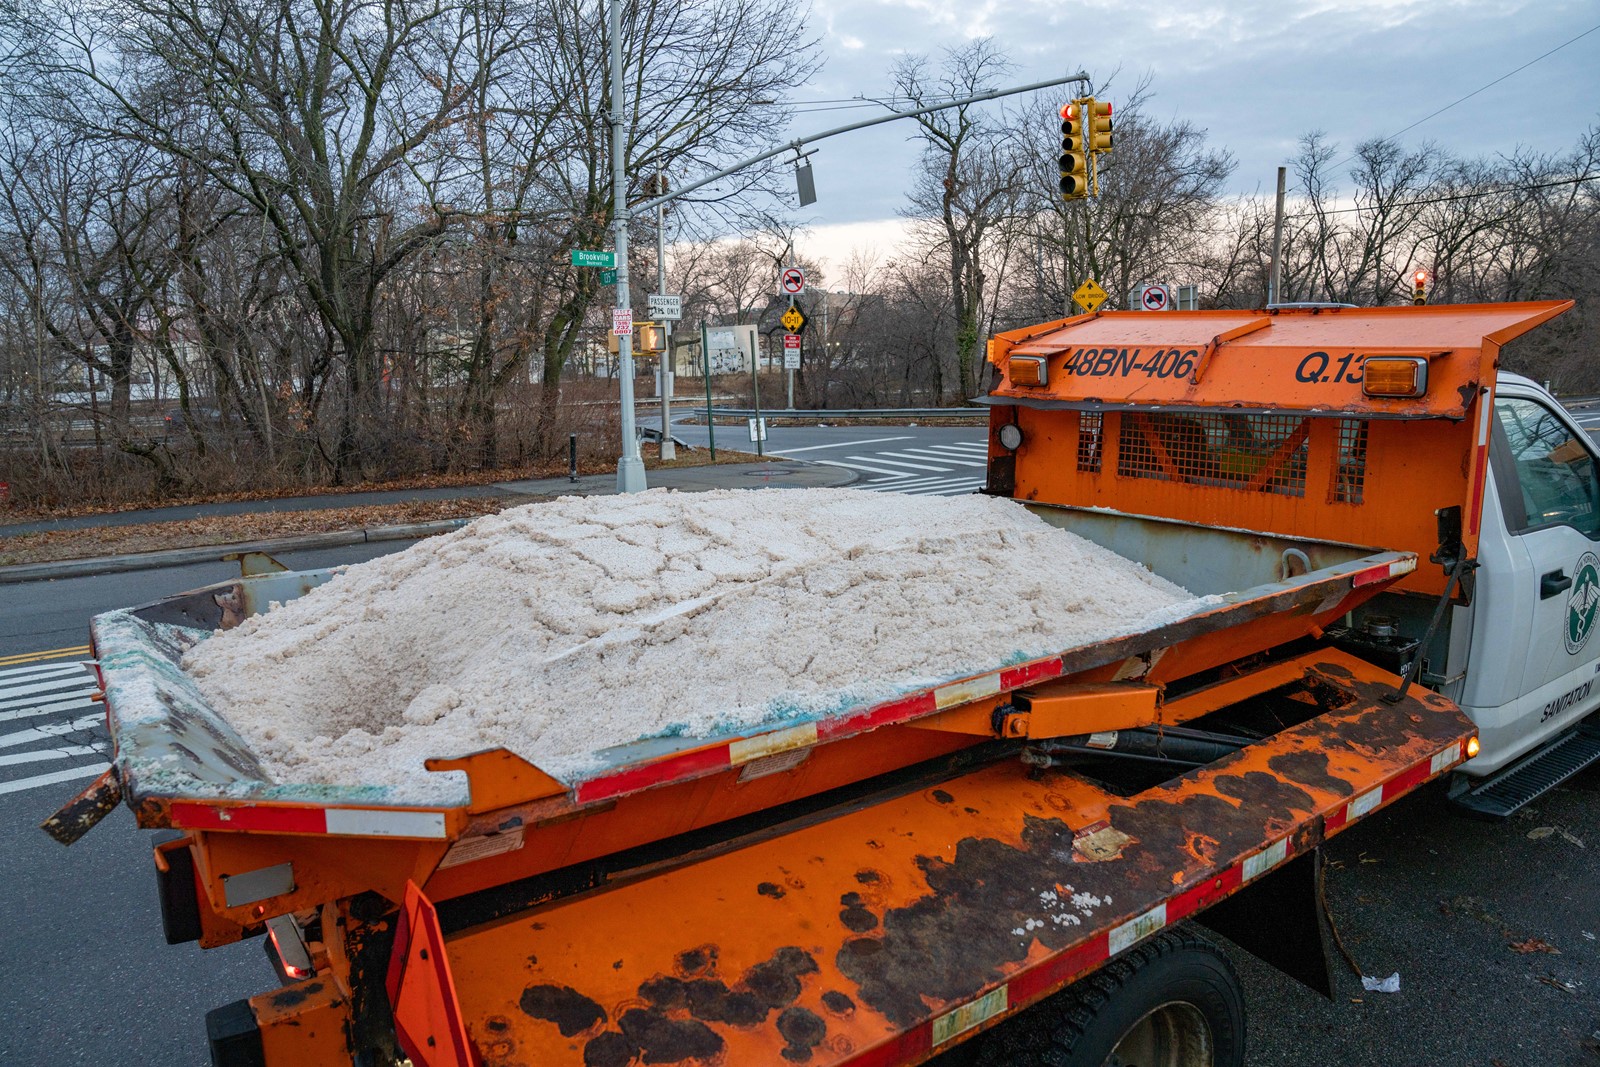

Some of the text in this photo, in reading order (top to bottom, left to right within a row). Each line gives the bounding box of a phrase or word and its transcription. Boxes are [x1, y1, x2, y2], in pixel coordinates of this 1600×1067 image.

[578, 252, 609, 261] Brookville
[1063, 348, 1198, 378] 48BN-406
[1295, 352, 1364, 384] Q.13
[1541, 679, 1594, 723] SANITATION
